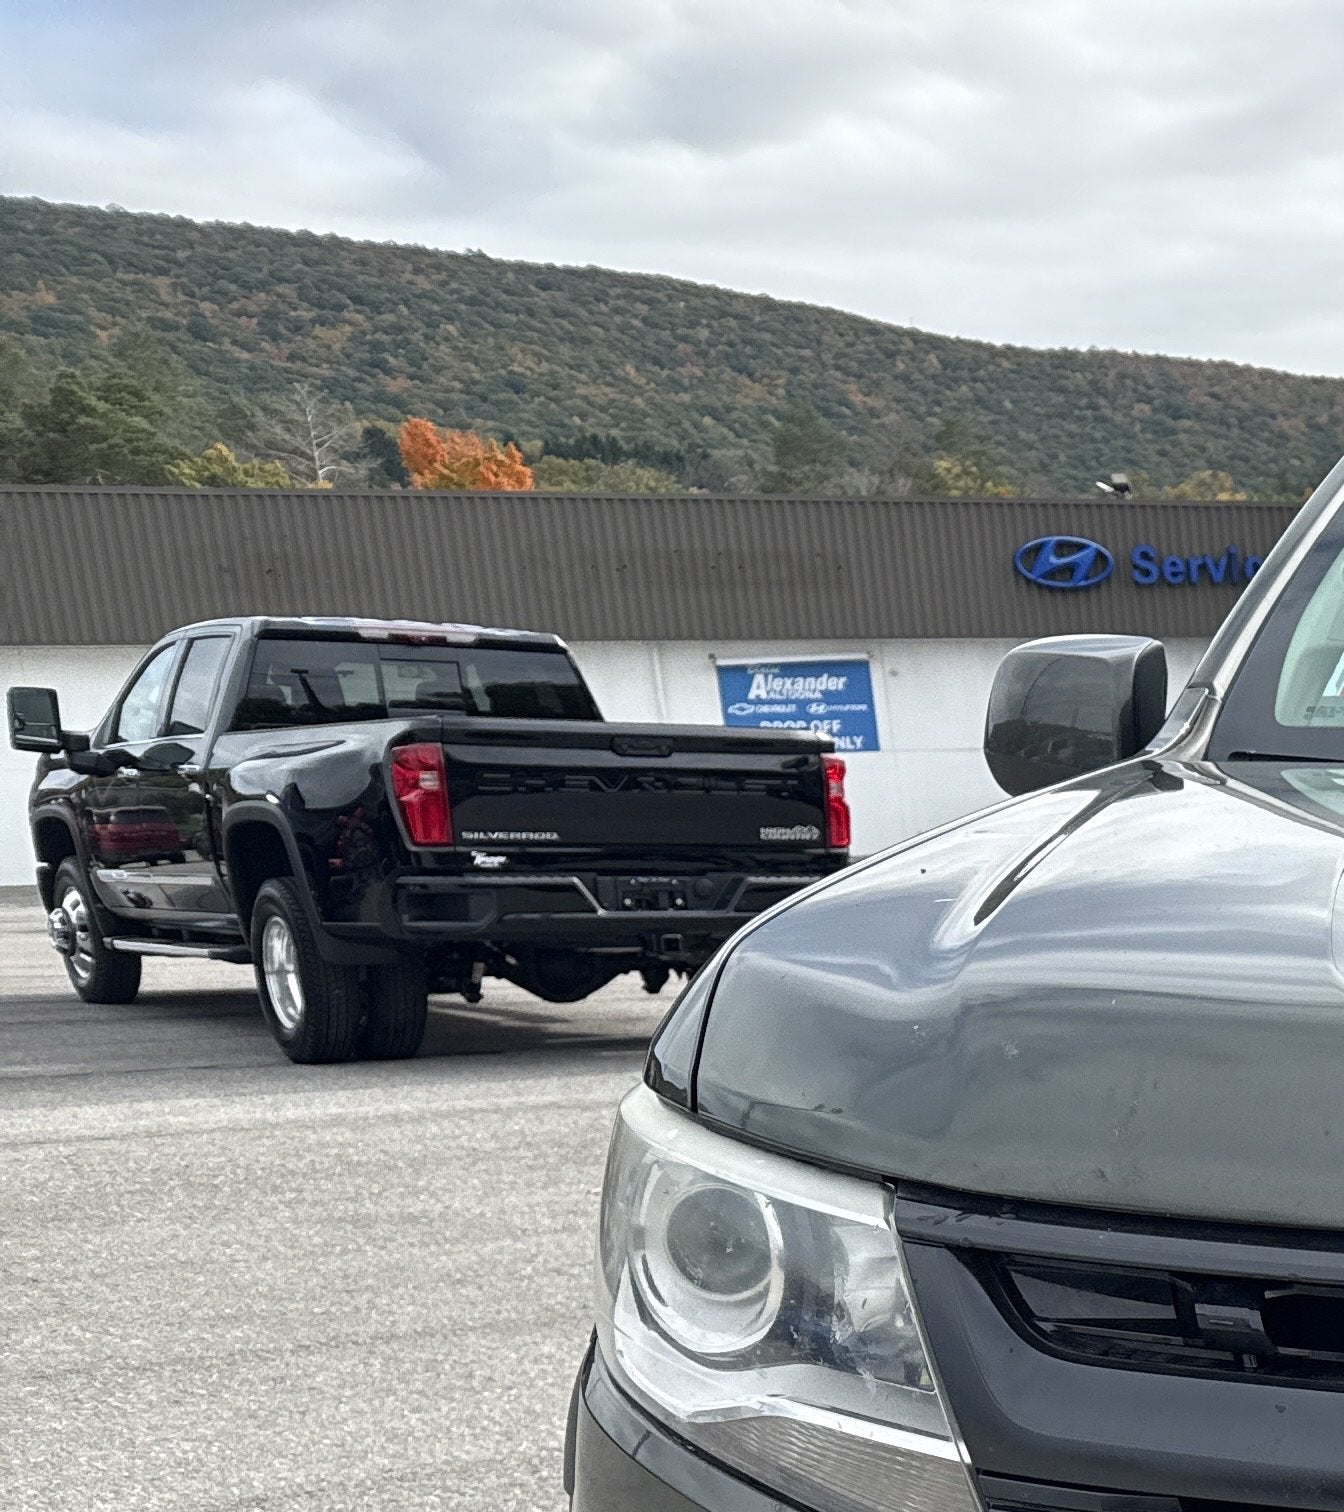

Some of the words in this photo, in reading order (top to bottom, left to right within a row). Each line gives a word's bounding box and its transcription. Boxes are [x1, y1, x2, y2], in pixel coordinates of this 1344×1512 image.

[747, 673, 848, 700] Alexander
[810, 719, 842, 734] OFF
[461, 831, 560, 841] SILVERADO
